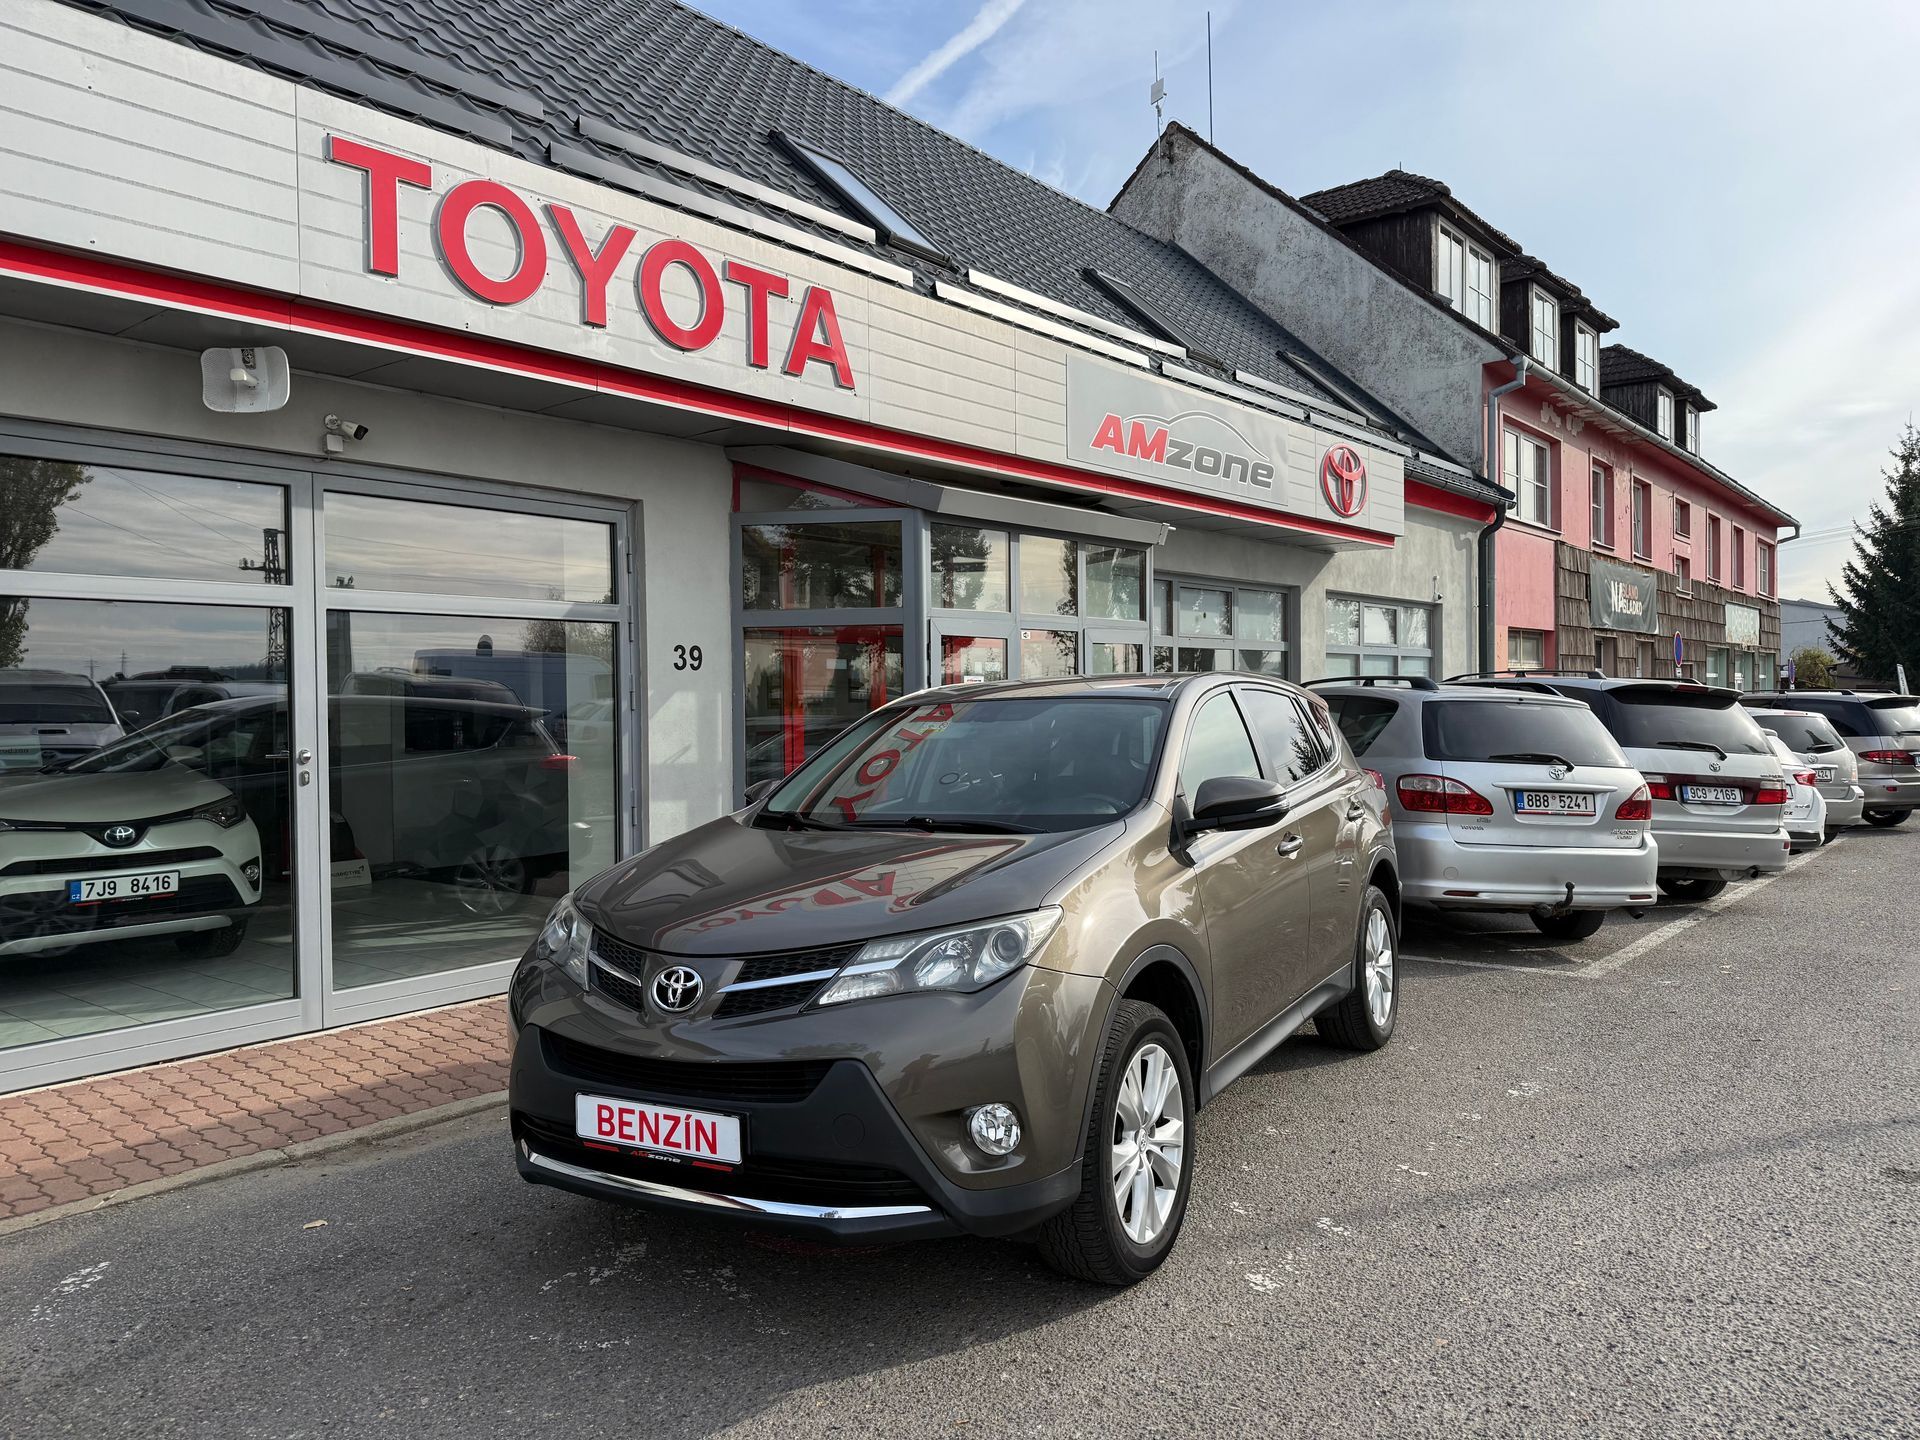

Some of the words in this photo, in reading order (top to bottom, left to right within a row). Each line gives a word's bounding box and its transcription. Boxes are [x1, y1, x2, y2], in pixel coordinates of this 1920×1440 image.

[328, 135, 855, 390] TOYOTA
[1089, 412, 1275, 490] AMzone
[673, 644, 703, 671] 39
[1526, 793, 1550, 808] 8B8
[1558, 795, 1588, 810] 5241
[1690, 787, 1708, 799] 9C9
[1713, 788, 1737, 801] 2165
[85, 880, 117, 898] 7J9
[130, 875, 171, 893] 8416
[597, 1103, 718, 1155] BENZÍN
[630, 1149, 682, 1164] AMzone
